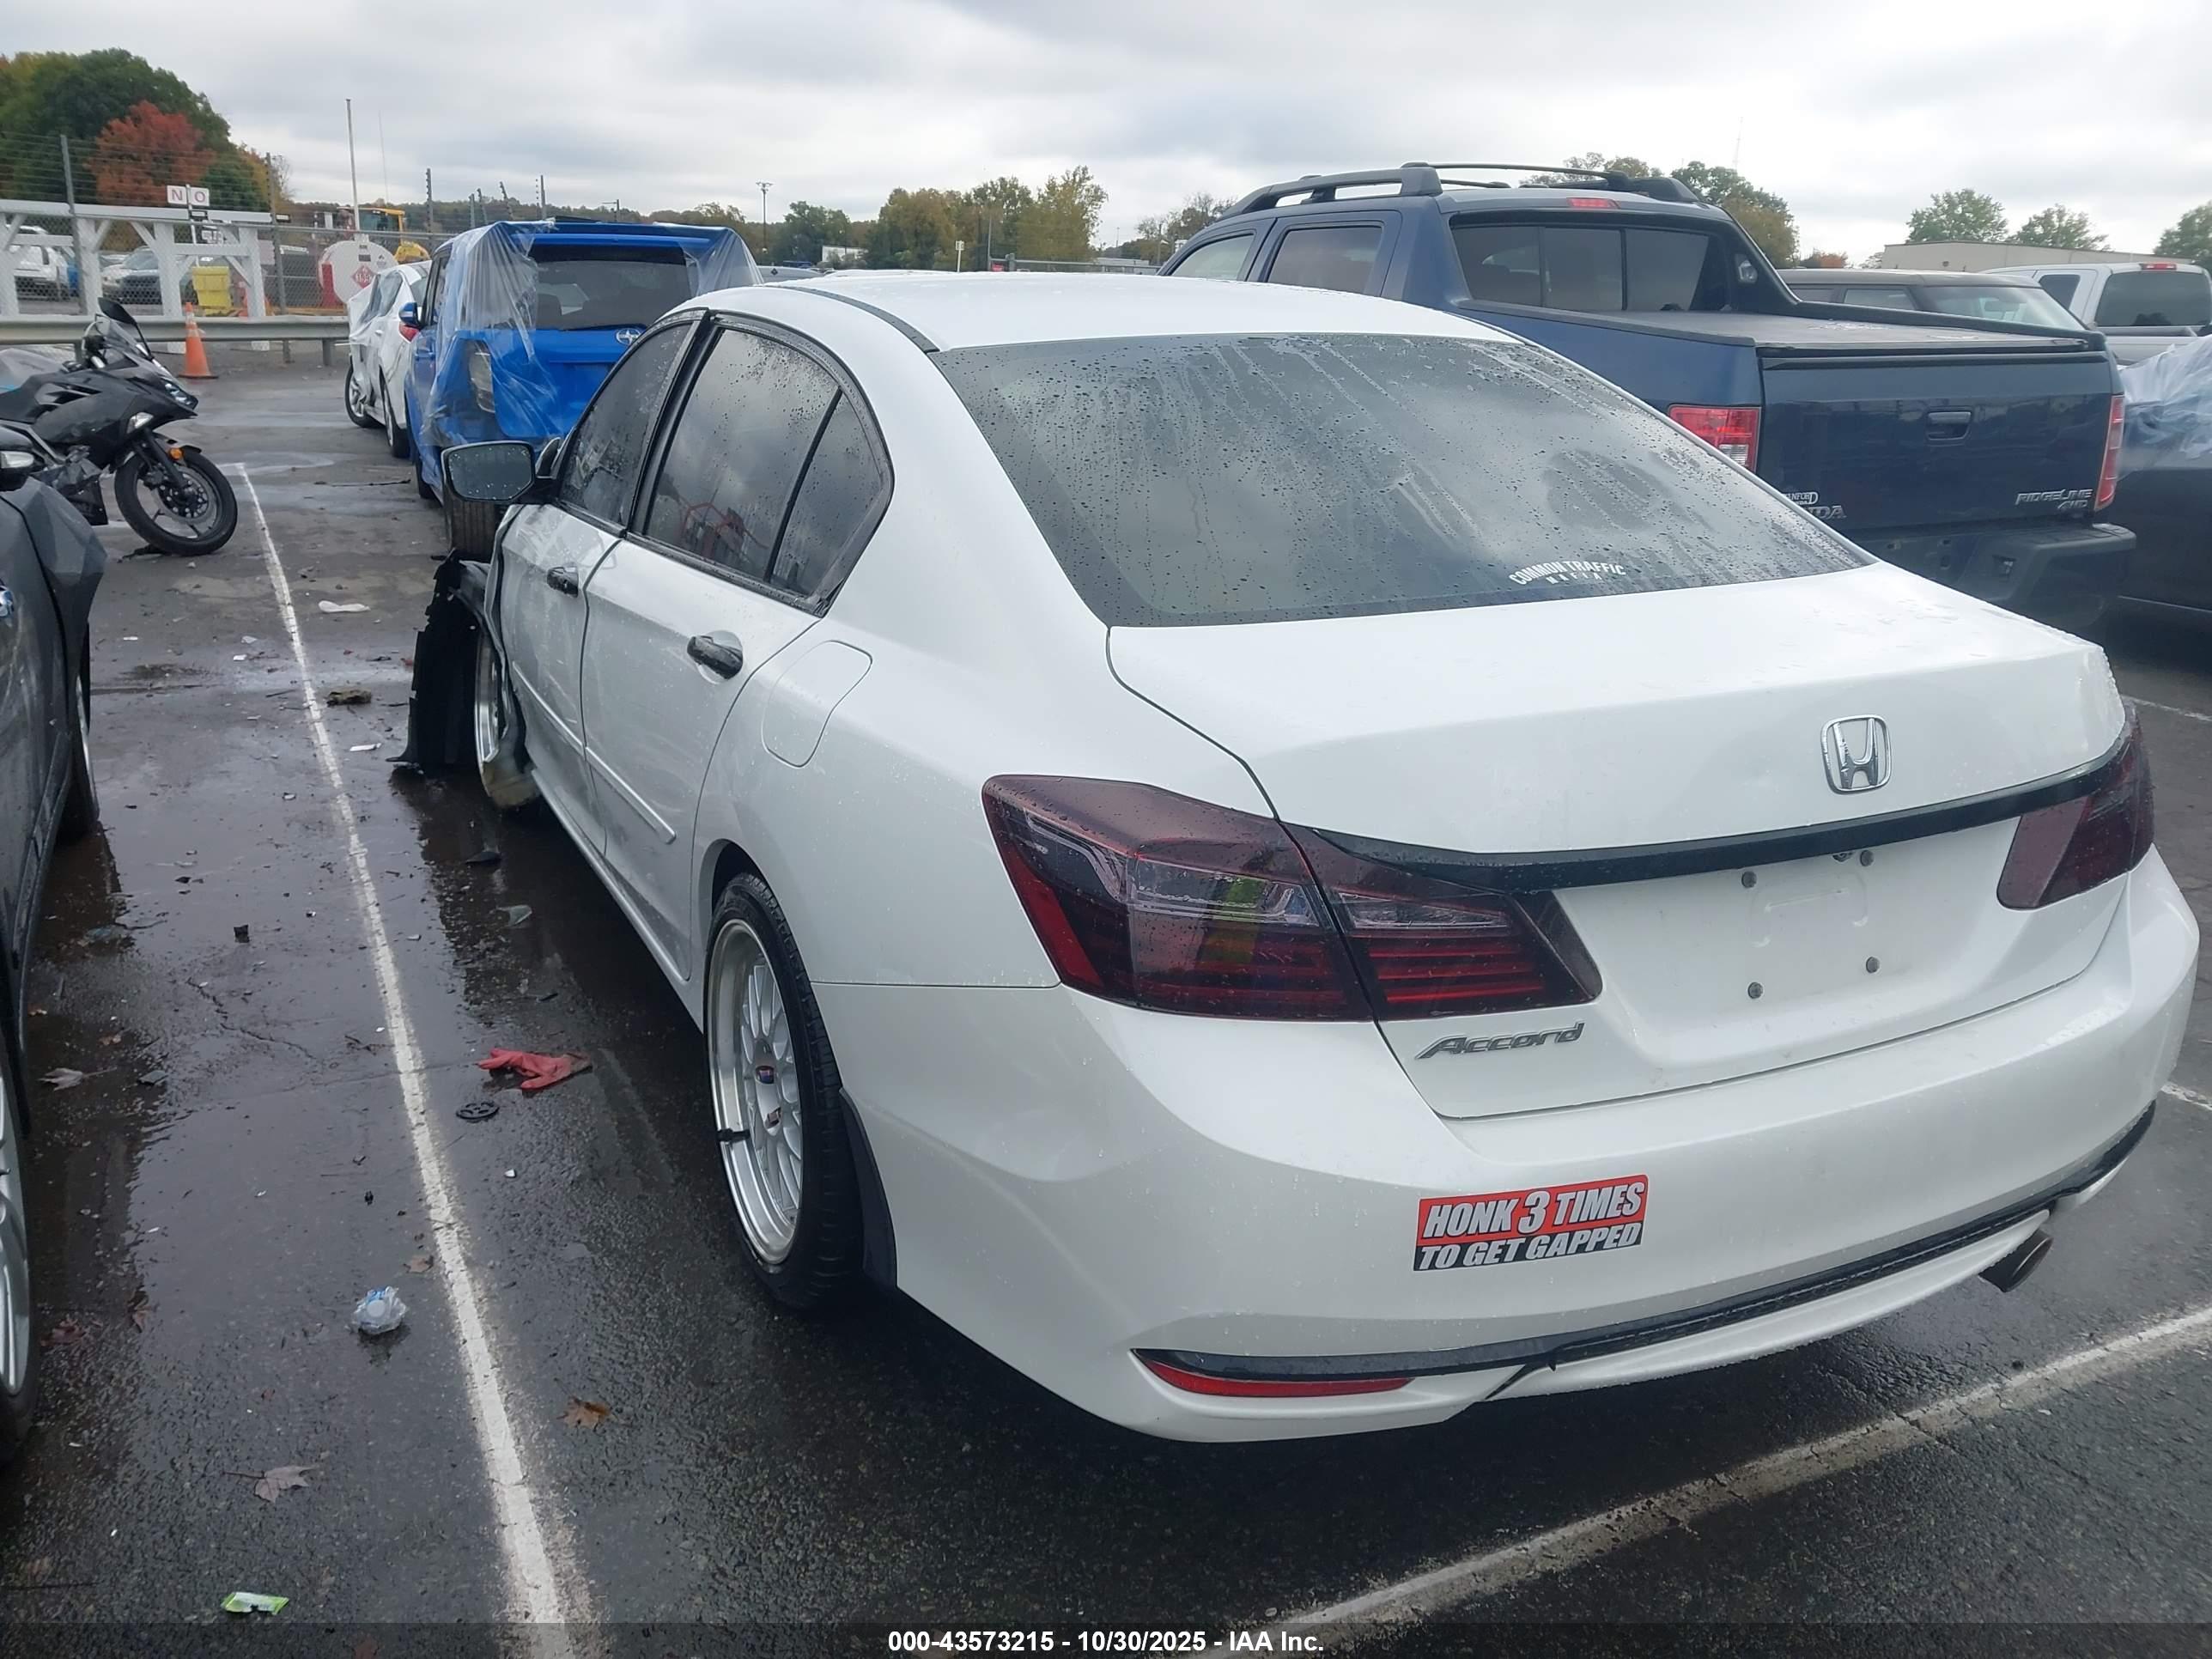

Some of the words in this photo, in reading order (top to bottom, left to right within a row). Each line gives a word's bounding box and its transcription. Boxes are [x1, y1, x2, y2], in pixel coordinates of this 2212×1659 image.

[2014, 489, 2094, 505] RIDGELINE
[1509, 561, 1568, 585] COMMON
[1564, 561, 1626, 575] TRAFFIC
[1546, 572, 1602, 585] MAFIA
[1415, 1021, 1585, 1060] Accord
[1422, 1198, 1521, 1239] HONK
[1517, 1190, 1550, 1235] 3
[1553, 1182, 1645, 1226] TIMES
[1419, 1244, 1461, 1270] TO
[1462, 1238, 1527, 1267] GET
[1525, 1222, 1643, 1260] GAPPED
